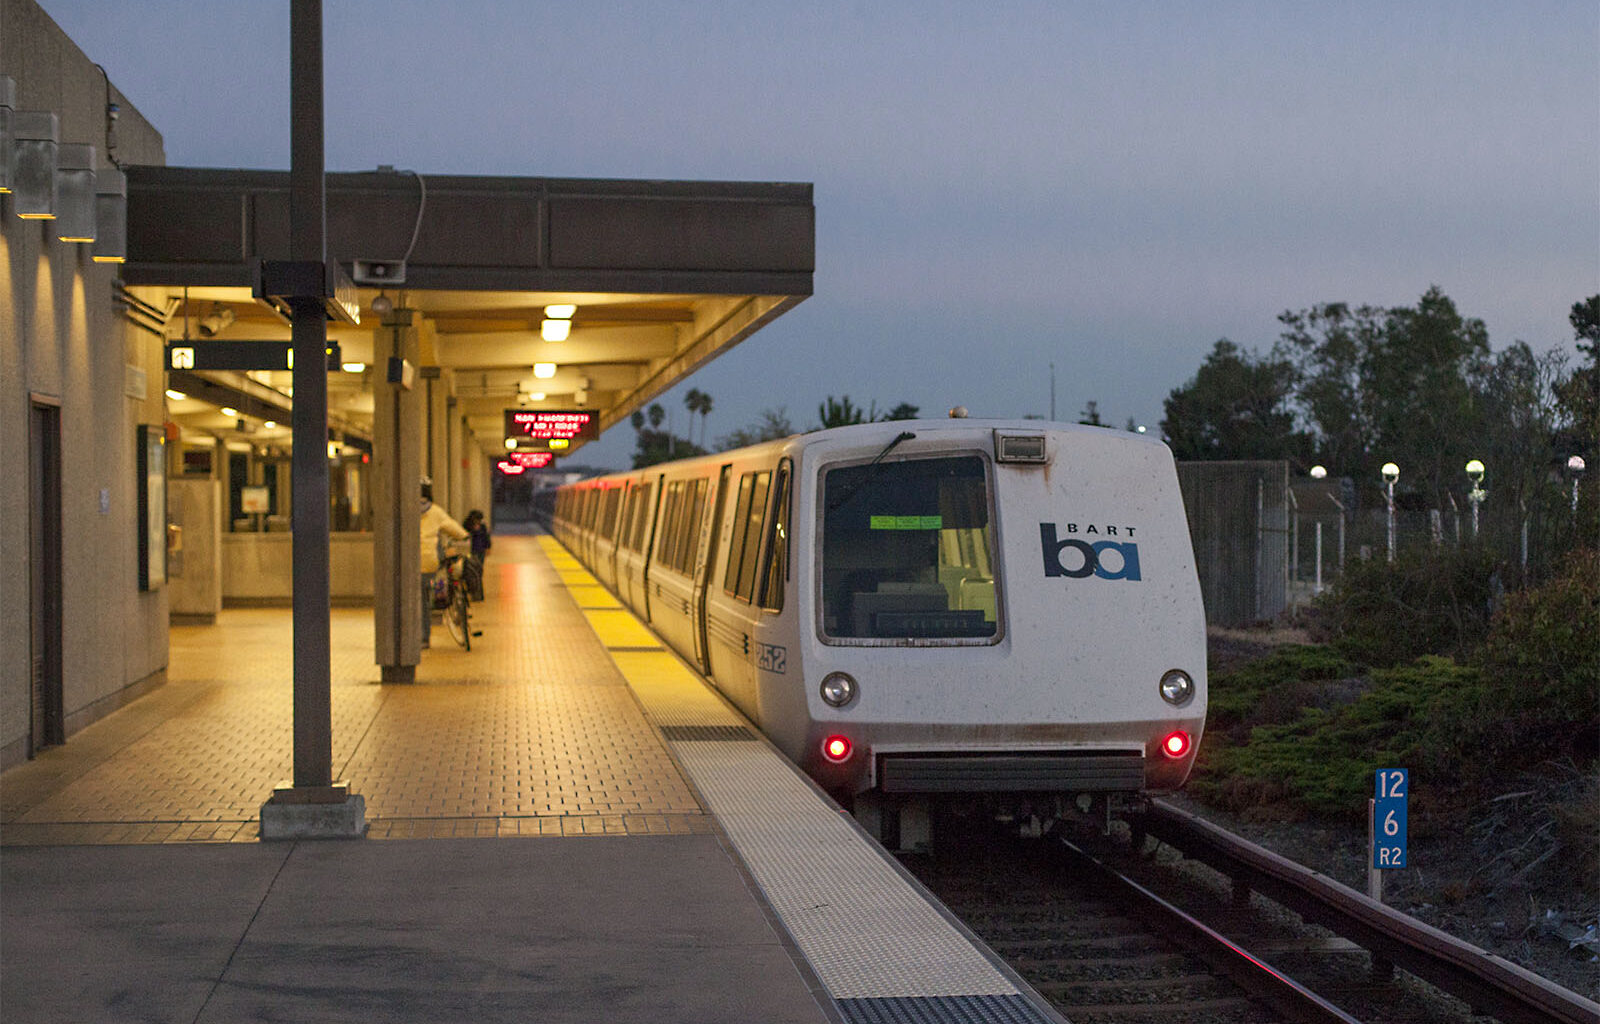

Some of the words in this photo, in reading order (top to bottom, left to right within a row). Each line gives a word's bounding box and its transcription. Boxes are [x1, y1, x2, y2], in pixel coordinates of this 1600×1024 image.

[1067, 523, 1136, 537] BART
[1039, 522, 1142, 581] ba
[756, 643, 786, 674] 252
[1380, 771, 1404, 798] 12
[1384, 809, 1399, 836] 6
[1380, 847, 1402, 865] R2
